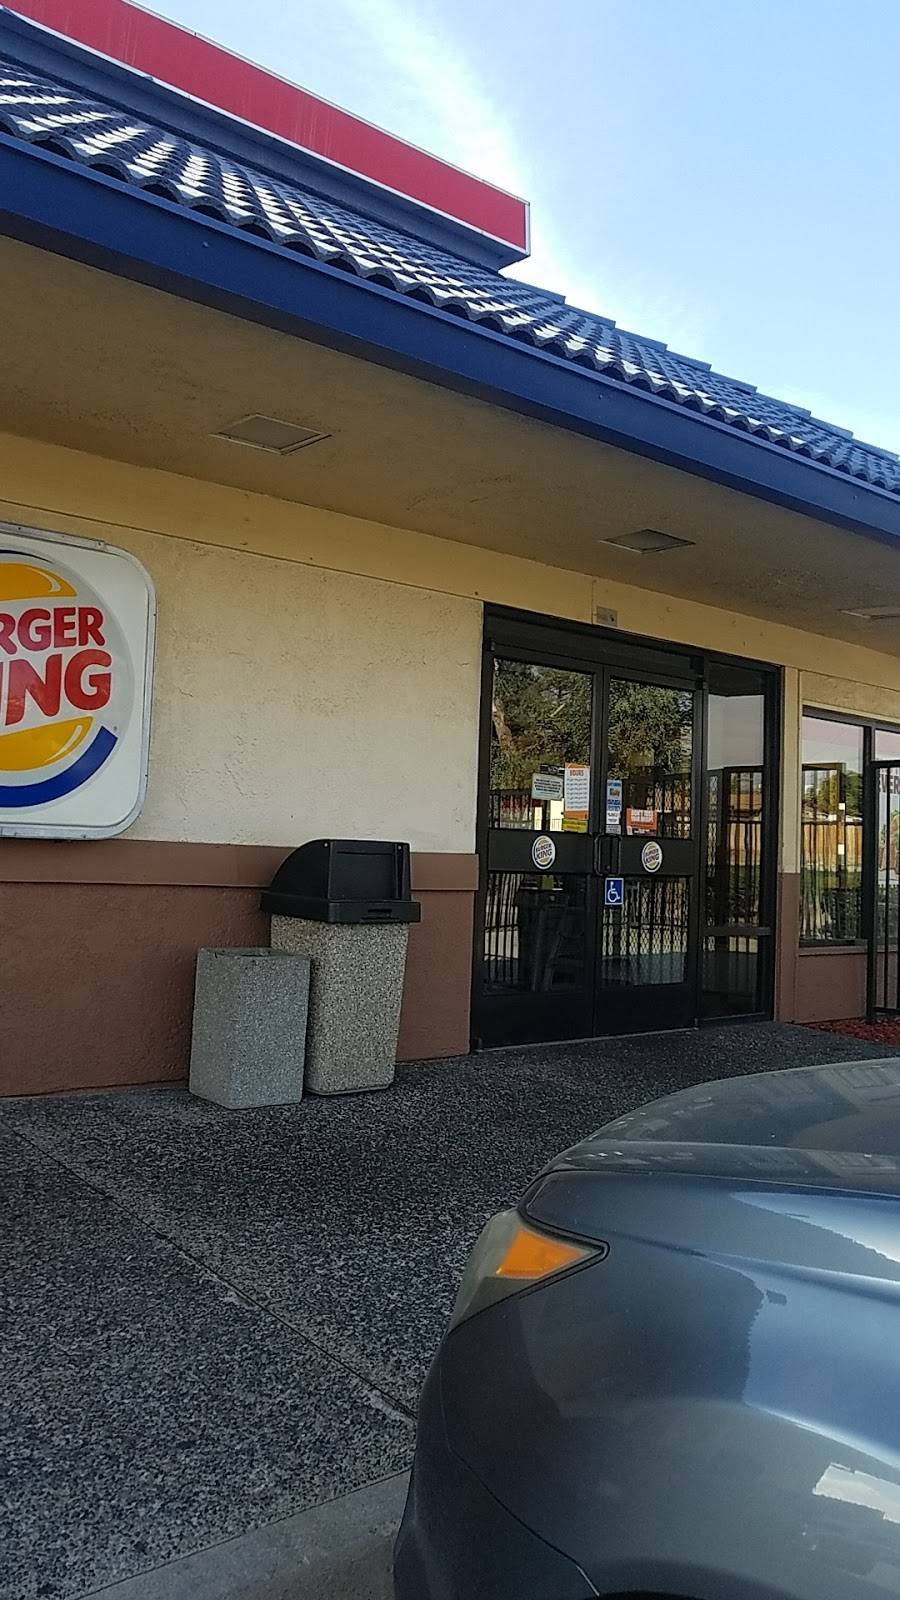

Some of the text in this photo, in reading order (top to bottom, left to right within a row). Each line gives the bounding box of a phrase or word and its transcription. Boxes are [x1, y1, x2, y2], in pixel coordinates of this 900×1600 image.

[0, 649, 112, 726] NG
[536, 843, 552, 852] BURGER
[645, 848, 659, 857] BURGER
[537, 848, 553, 859] KING
[645, 853, 660, 864] KING
